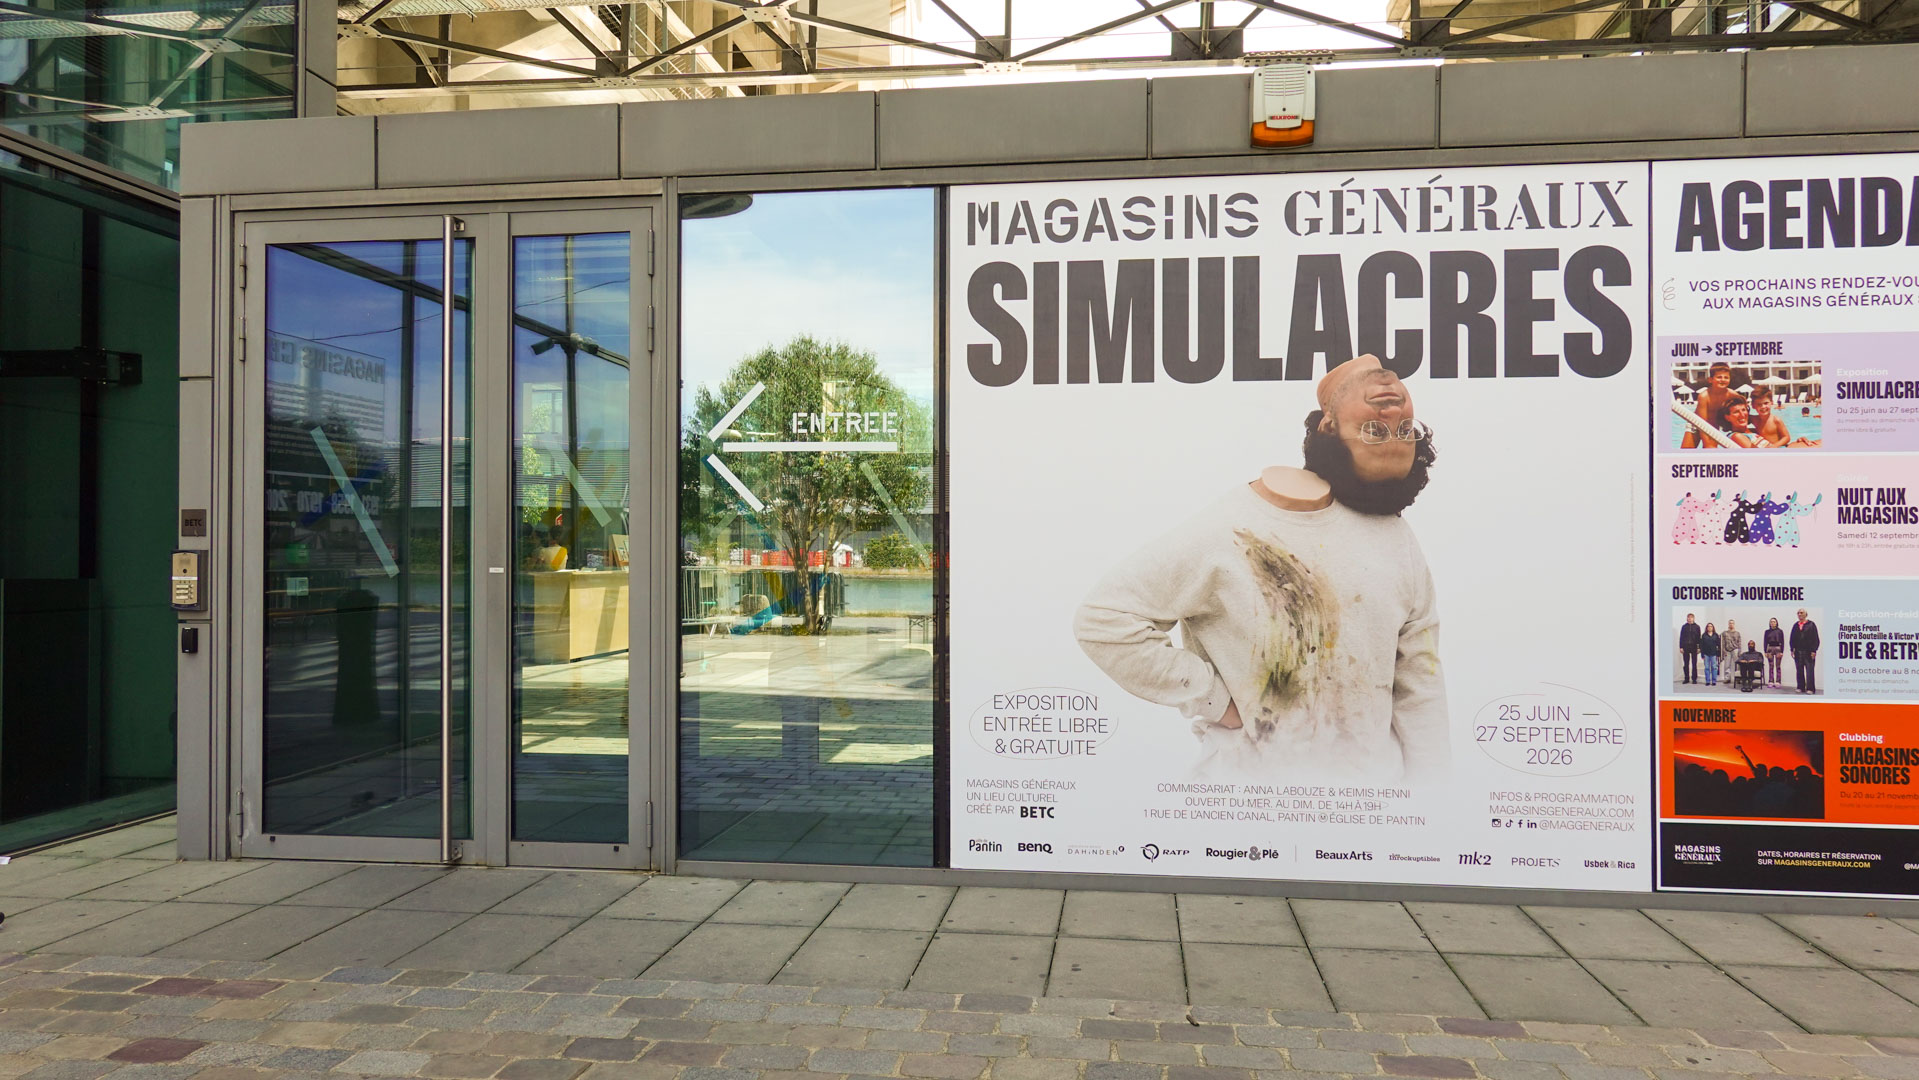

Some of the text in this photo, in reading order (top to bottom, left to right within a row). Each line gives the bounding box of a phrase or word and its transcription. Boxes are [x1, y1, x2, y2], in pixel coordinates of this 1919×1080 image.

[967, 174, 1633, 246] MAGASINS GÉNÉRAUX
[1689, 280, 1720, 292] VOS
[1724, 278, 1816, 291] PROCHAINS
[1702, 292, 1914, 310] AUX MAGASINS GÉNÉRAUX
[966, 245, 1632, 387] SIMULACRES
[1672, 341, 1783, 357] JUIN SEPTEMBRE
[1836, 368, 1888, 378] Exposition
[1861, 406, 1876, 415] juin
[792, 412, 898, 434] ENTREE
[1672, 464, 1739, 478] SEPTEMBRE
[1838, 488, 1906, 505] NUIT AUX
[1838, 506, 1918, 524] MAGASINS
[1672, 586, 1804, 601] OCTOBRE NOVEMBRE
[1840, 624, 1861, 632] Angels
[1838, 632, 1857, 640] (Flora
[1839, 642, 1919, 660] DIE & RETR
[993, 694, 1098, 711] EXPOSITION
[1499, 704, 1521, 720] 25
[1526, 705, 1570, 721] JUIN
[1673, 708, 1736, 723] NOVEMBRE
[983, 714, 1108, 733] ENTRÉE LIBRE
[1476, 726, 1623, 744] 27 SEPTEMBRE
[1839, 733, 1883, 744] Clubbing
[995, 738, 1096, 755] & GRATUITE
[1526, 748, 1572, 765] 2026
[1840, 747, 1919, 766] MAGASINS
[1840, 766, 1910, 785] SONORES
[966, 779, 1076, 790] MAGASINS GÉNÉRAUX
[1157, 783, 1236, 793] COMMISSARIAT
[1244, 785, 1274, 795] ANNA
[1277, 786, 1325, 796] LABOUZE
[1328, 788, 1336, 796] &
[1339, 788, 1374, 798] KEIMIS
[1378, 789, 1410, 798] HENNI
[966, 792, 1058, 802] UN LIEU CULTUREL
[1185, 797, 1227, 807] OUVERT
[1229, 798, 1244, 807] DU
[1248, 799, 1272, 808] MER.
[1276, 800, 1289, 809] AU
[1293, 800, 1314, 810] DIM.
[1319, 801, 1332, 810] DE
[1336, 801, 1352, 810] 14H
[1364, 802, 1381, 811] 19H
[1489, 792, 1634, 804] INFOS & PROGRAMMATION
[966, 803, 1055, 818] CRÉÉ PAR BETC
[1150, 809, 1171, 818] RUE
[1174, 810, 1187, 819] DE
[1237, 811, 1275, 822] CANAL,
[1278, 812, 1315, 822] PANTIN
[1330, 812, 1366, 824] ÉGLISE
[1369, 815, 1383, 824] DE
[1386, 816, 1425, 825] PANTIN
[1489, 805, 1634, 818] MAGASINSGENERAUX.COM
[1540, 820, 1635, 832] @MAGGENERAUX
[969, 839, 1002, 852] Pantin
[1018, 842, 1053, 854] BenQ
[1675, 845, 1721, 853] MAGASINS
[1458, 852, 1492, 866] mk2
[1511, 857, 1560, 867] PROJETS
[1774, 859, 1871, 868] MAGASINSGENERAUX.COM
[1832, 852, 1881, 861] RÉSERVATION
